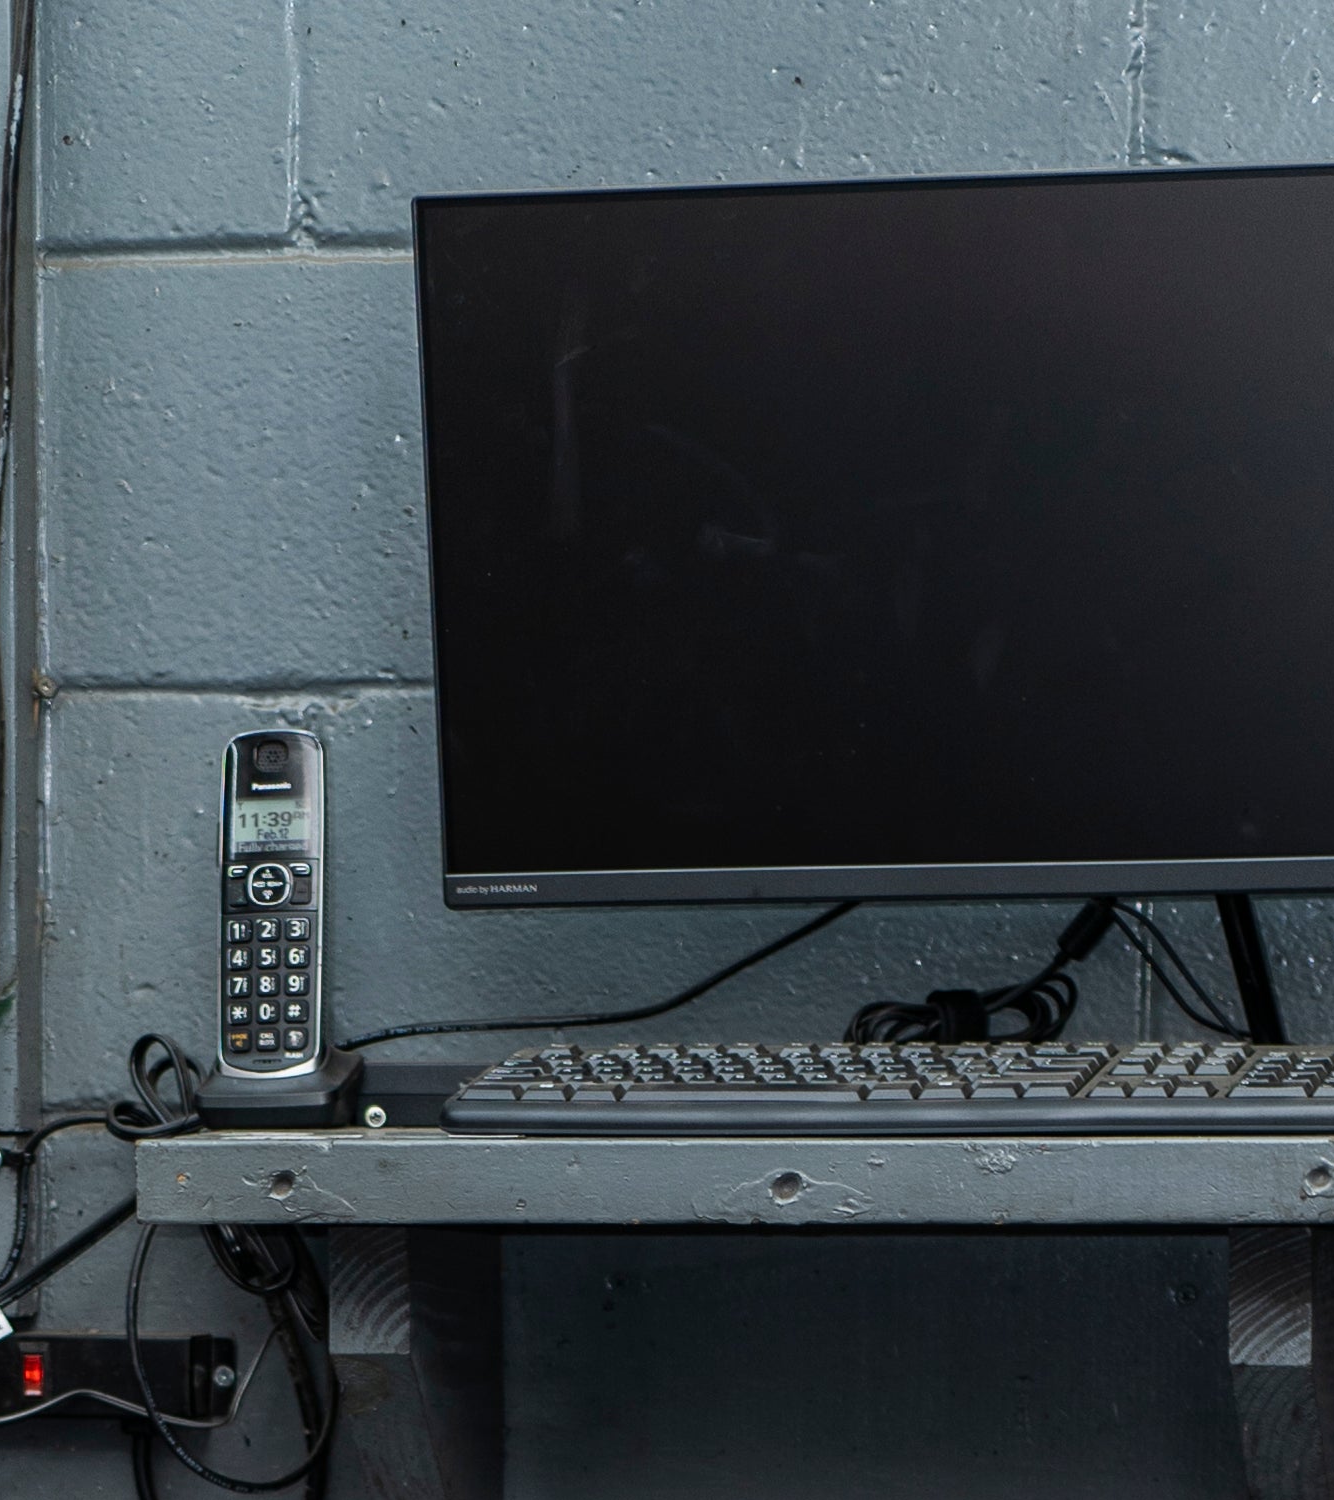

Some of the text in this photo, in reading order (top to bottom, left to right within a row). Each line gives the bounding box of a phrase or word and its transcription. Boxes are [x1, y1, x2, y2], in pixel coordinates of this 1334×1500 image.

[238, 812, 292, 828] 11:39
[490, 884, 537, 893] HARMAN
[233, 923, 240, 939] 1
[261, 922, 272, 938] 2
[290, 921, 301, 937] 3
[232, 950, 243, 966] 4
[261, 949, 272, 965] 5
[288, 948, 300, 964] 6
[233, 977, 243, 993] 7
[260, 976, 271, 992] 8
[288, 976, 300, 992] 9
[259, 1004, 270, 1020] 0
